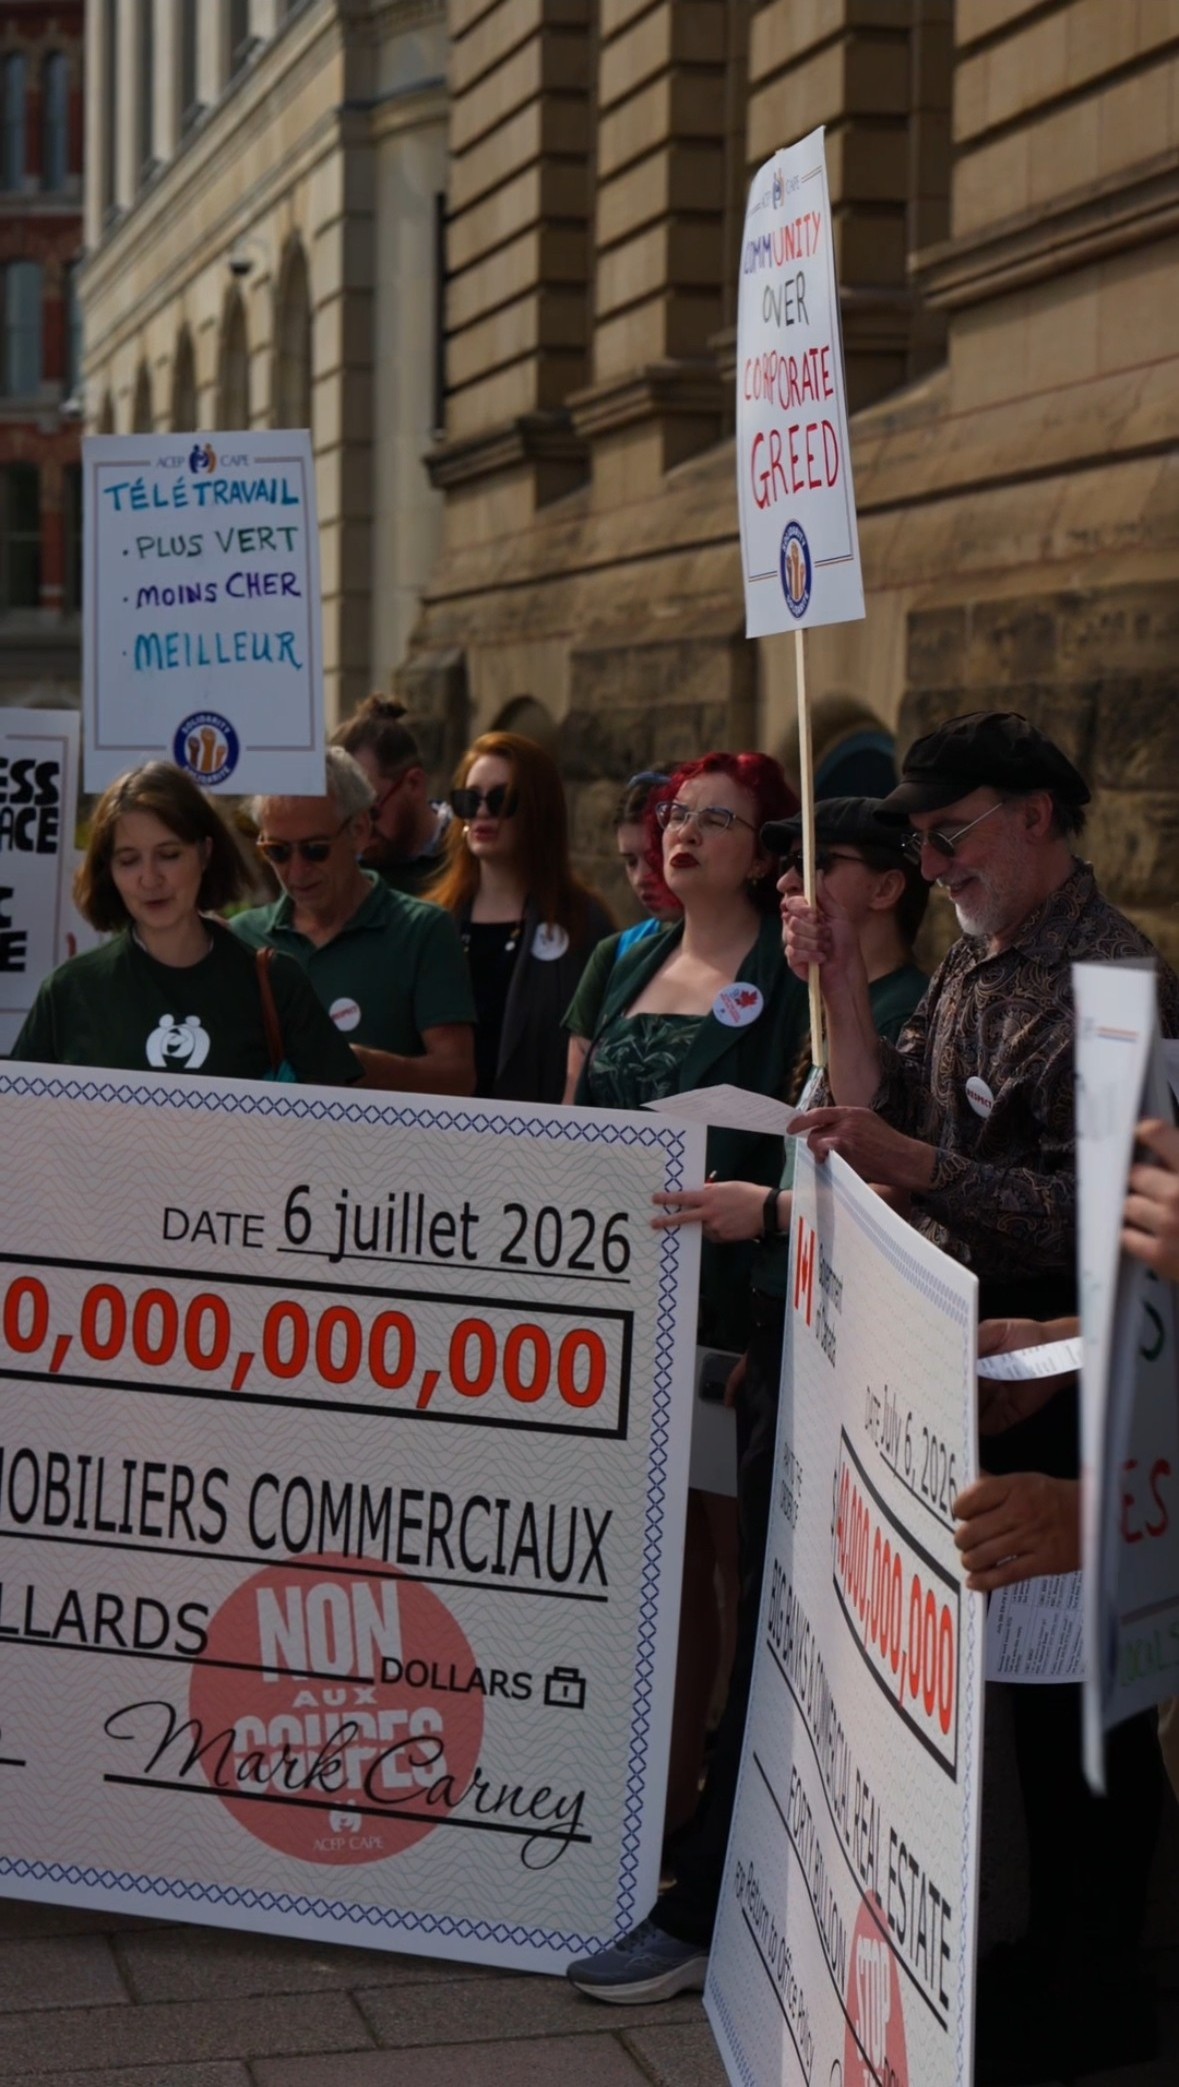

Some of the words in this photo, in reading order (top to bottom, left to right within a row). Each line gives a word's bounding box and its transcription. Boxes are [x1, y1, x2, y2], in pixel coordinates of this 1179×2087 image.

[763, 271, 809, 328] OVER
[745, 346, 834, 410] CORPORATE
[104, 476, 299, 511] TÉLÉTRAVAIL
[751, 420, 839, 509] GREED
[136, 535, 202, 558] PLUS
[215, 527, 298, 552] VERT
[136, 583, 217, 609] MOINS
[226, 572, 301, 598] CHER
[134, 632, 302, 671] MEILLEUR
[162, 1207, 265, 1248] DATE
[283, 1184, 312, 1245] 6
[328, 1188, 479, 1263] juillet
[500, 1202, 631, 1274] 2026
[3, 1276, 607, 1409] 0,000,000,000
[880, 1384, 902, 1477] July
[921, 1427, 958, 1521] 2026
[0, 1447, 229, 1544] OBILIERS
[249, 1473, 613, 1586] COMMERCIAUX
[256, 1579, 403, 1683] NON
[292, 1688, 378, 1708] AUX
[380, 1657, 532, 1700] DOLLARS
[104, 1700, 358, 1793] Mark
[363, 1735, 585, 1870] Carney
[787, 1764, 815, 1879] FORTY
[813, 1839, 847, 1996] BILLION
[853, 1767, 882, 1911] REAL
[887, 1827, 952, 2012] ESTATE
[856, 1934, 892, 2069] STOP
